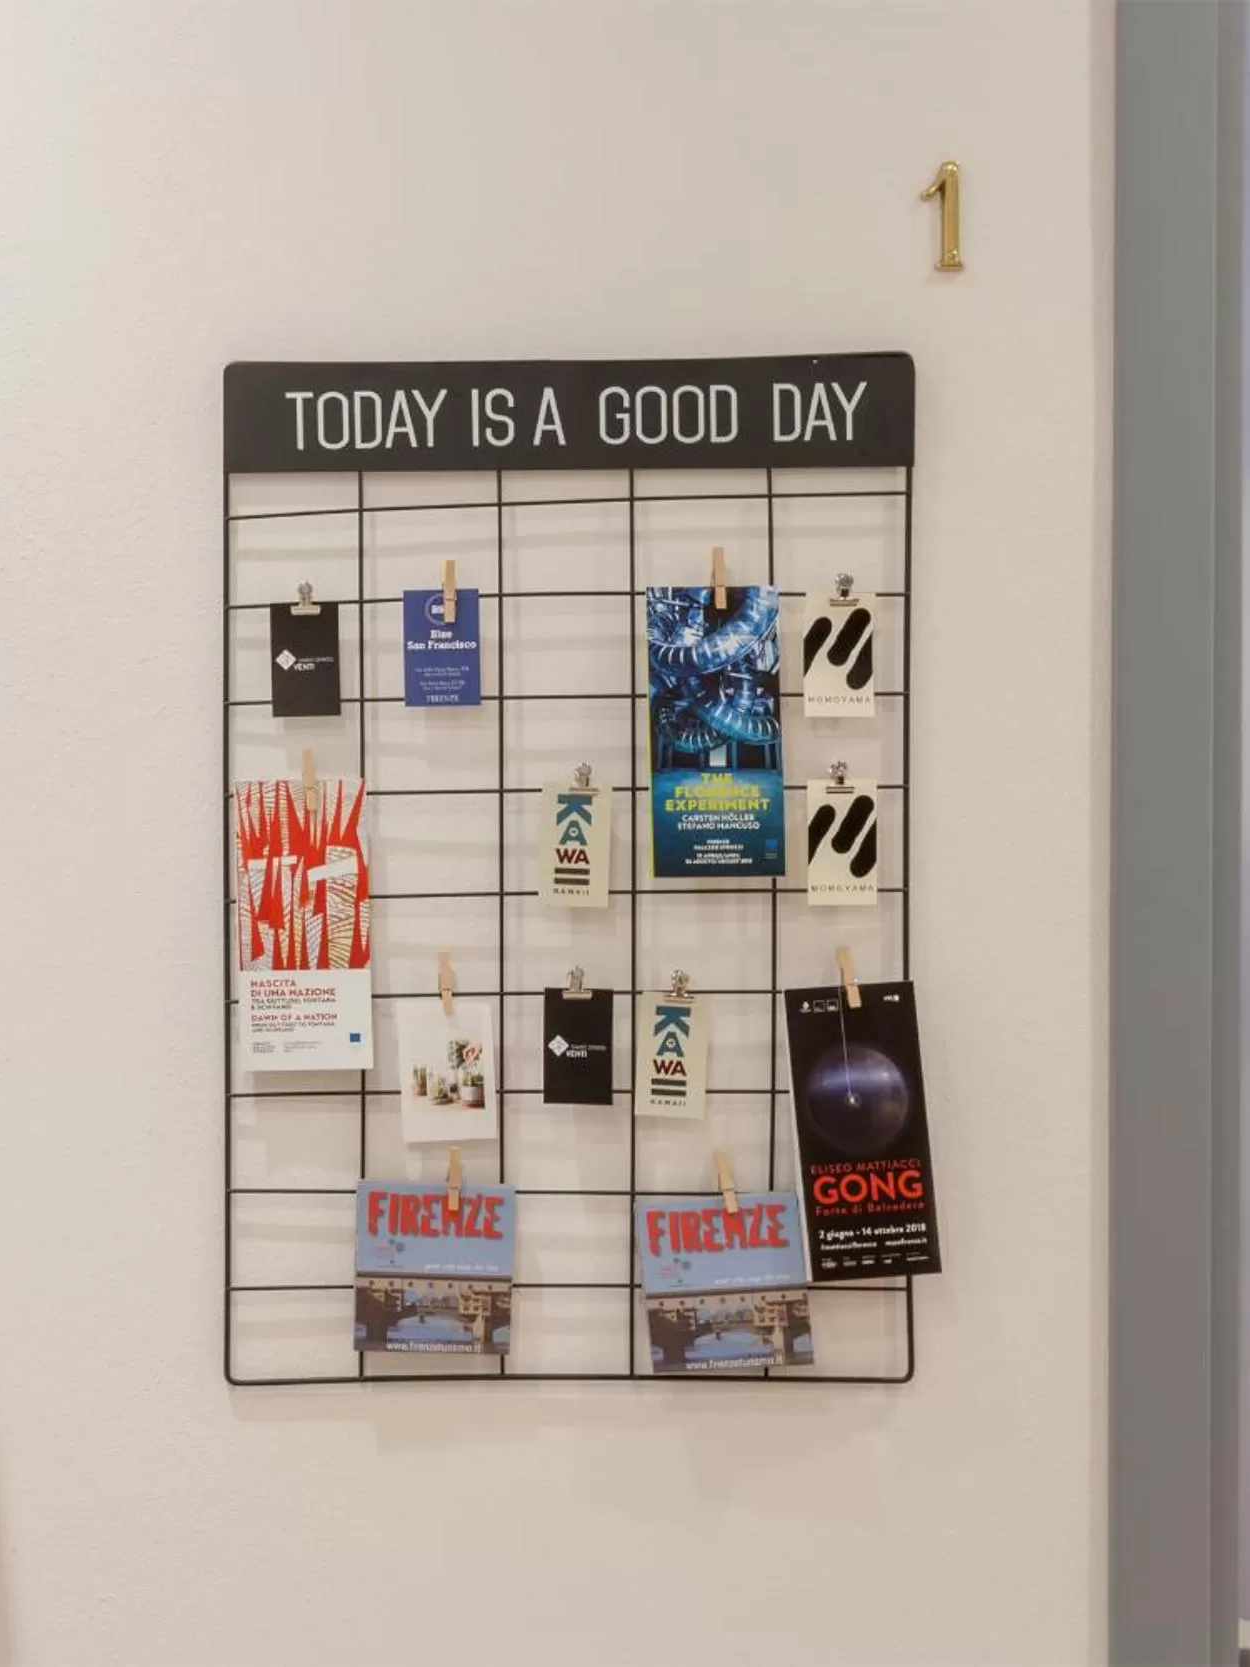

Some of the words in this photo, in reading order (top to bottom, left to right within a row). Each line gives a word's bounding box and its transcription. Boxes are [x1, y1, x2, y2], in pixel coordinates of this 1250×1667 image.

[920, 160, 964, 272] 1
[285, 388, 448, 450] TODAY
[471, 387, 516, 447] IS
[532, 386, 566, 446] A
[597, 383, 739, 446] GOOD
[772, 381, 868, 443] DAY
[406, 641, 426, 650] San
[427, 640, 478, 650] Francisco
[664, 798, 771, 812] EXPERIMENT
[856, 1159, 921, 1172] MATTIACCI
[813, 1169, 924, 1205] GONG
[367, 1190, 506, 1241] FIRENZE
[645, 1203, 791, 1257] FIRENZE
[905, 1223, 927, 1233] 2018
